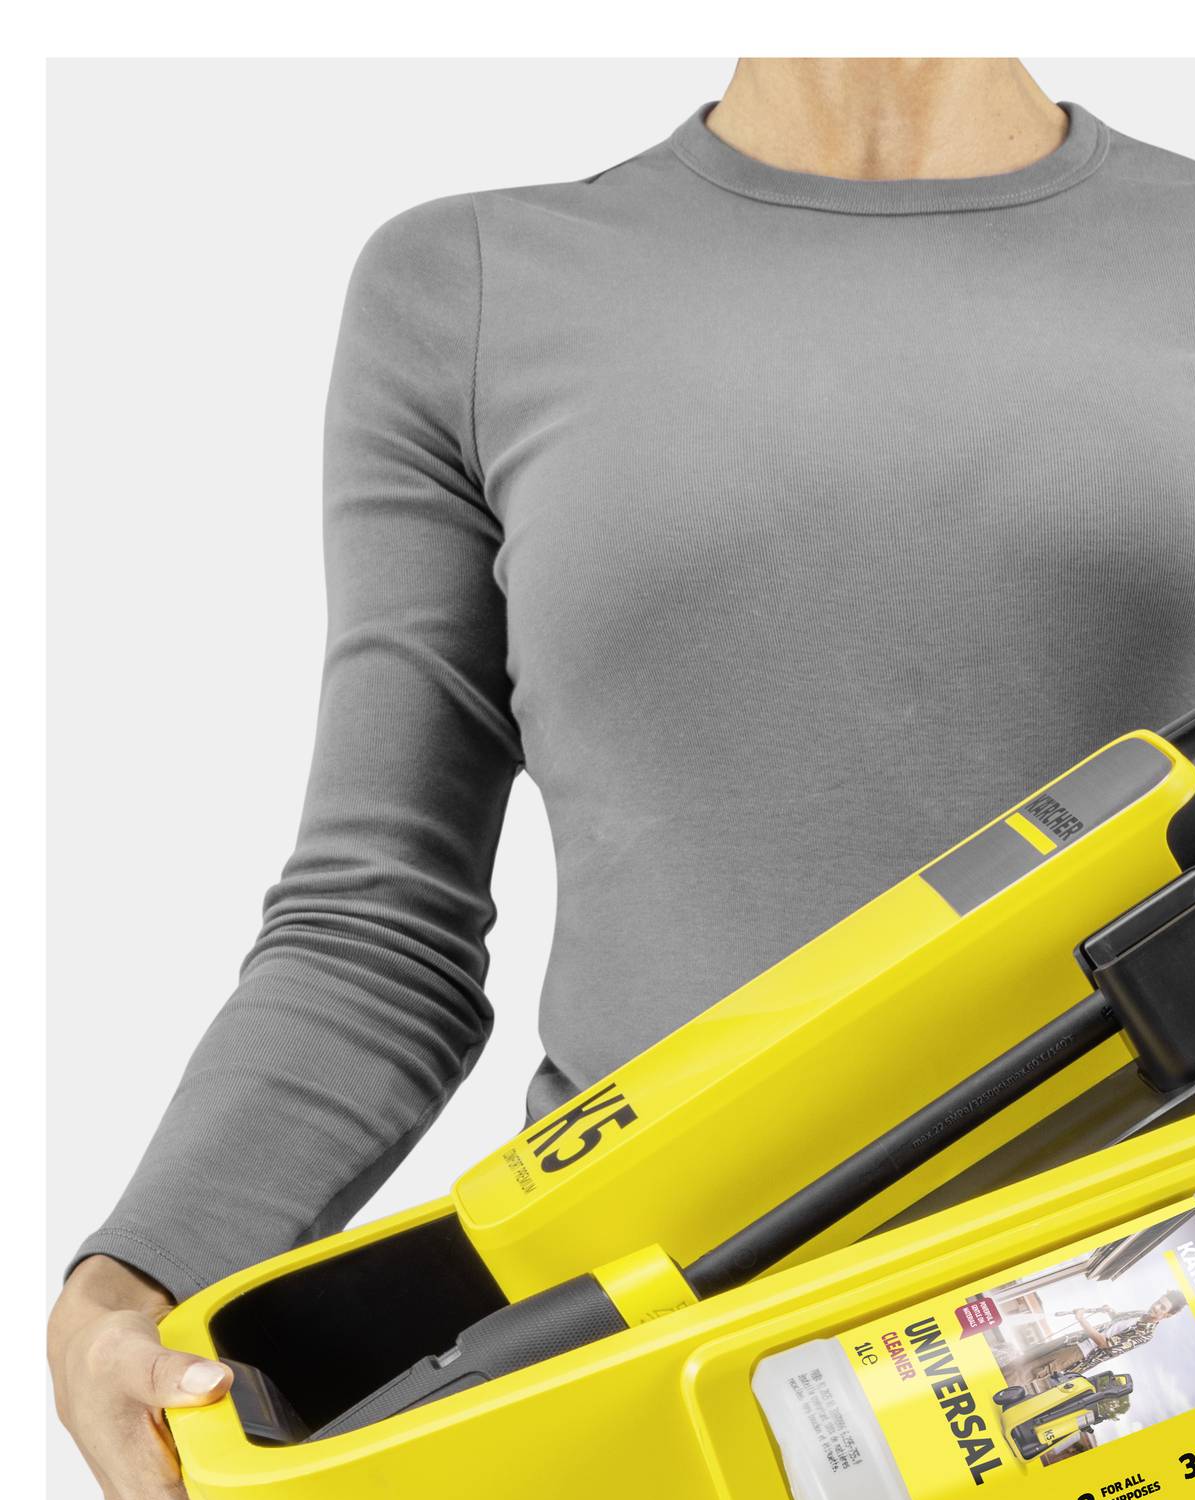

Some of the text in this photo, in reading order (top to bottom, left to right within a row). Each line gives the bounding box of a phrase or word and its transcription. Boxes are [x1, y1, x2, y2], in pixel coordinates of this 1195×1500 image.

[526, 1082, 638, 1173] K5
[881, 1332, 916, 1382] CLEANER
[905, 1317, 1002, 1485] UNIVERSAL
[1101, 1482, 1123, 1497] FOR
[1125, 1473, 1145, 1488] ALL
